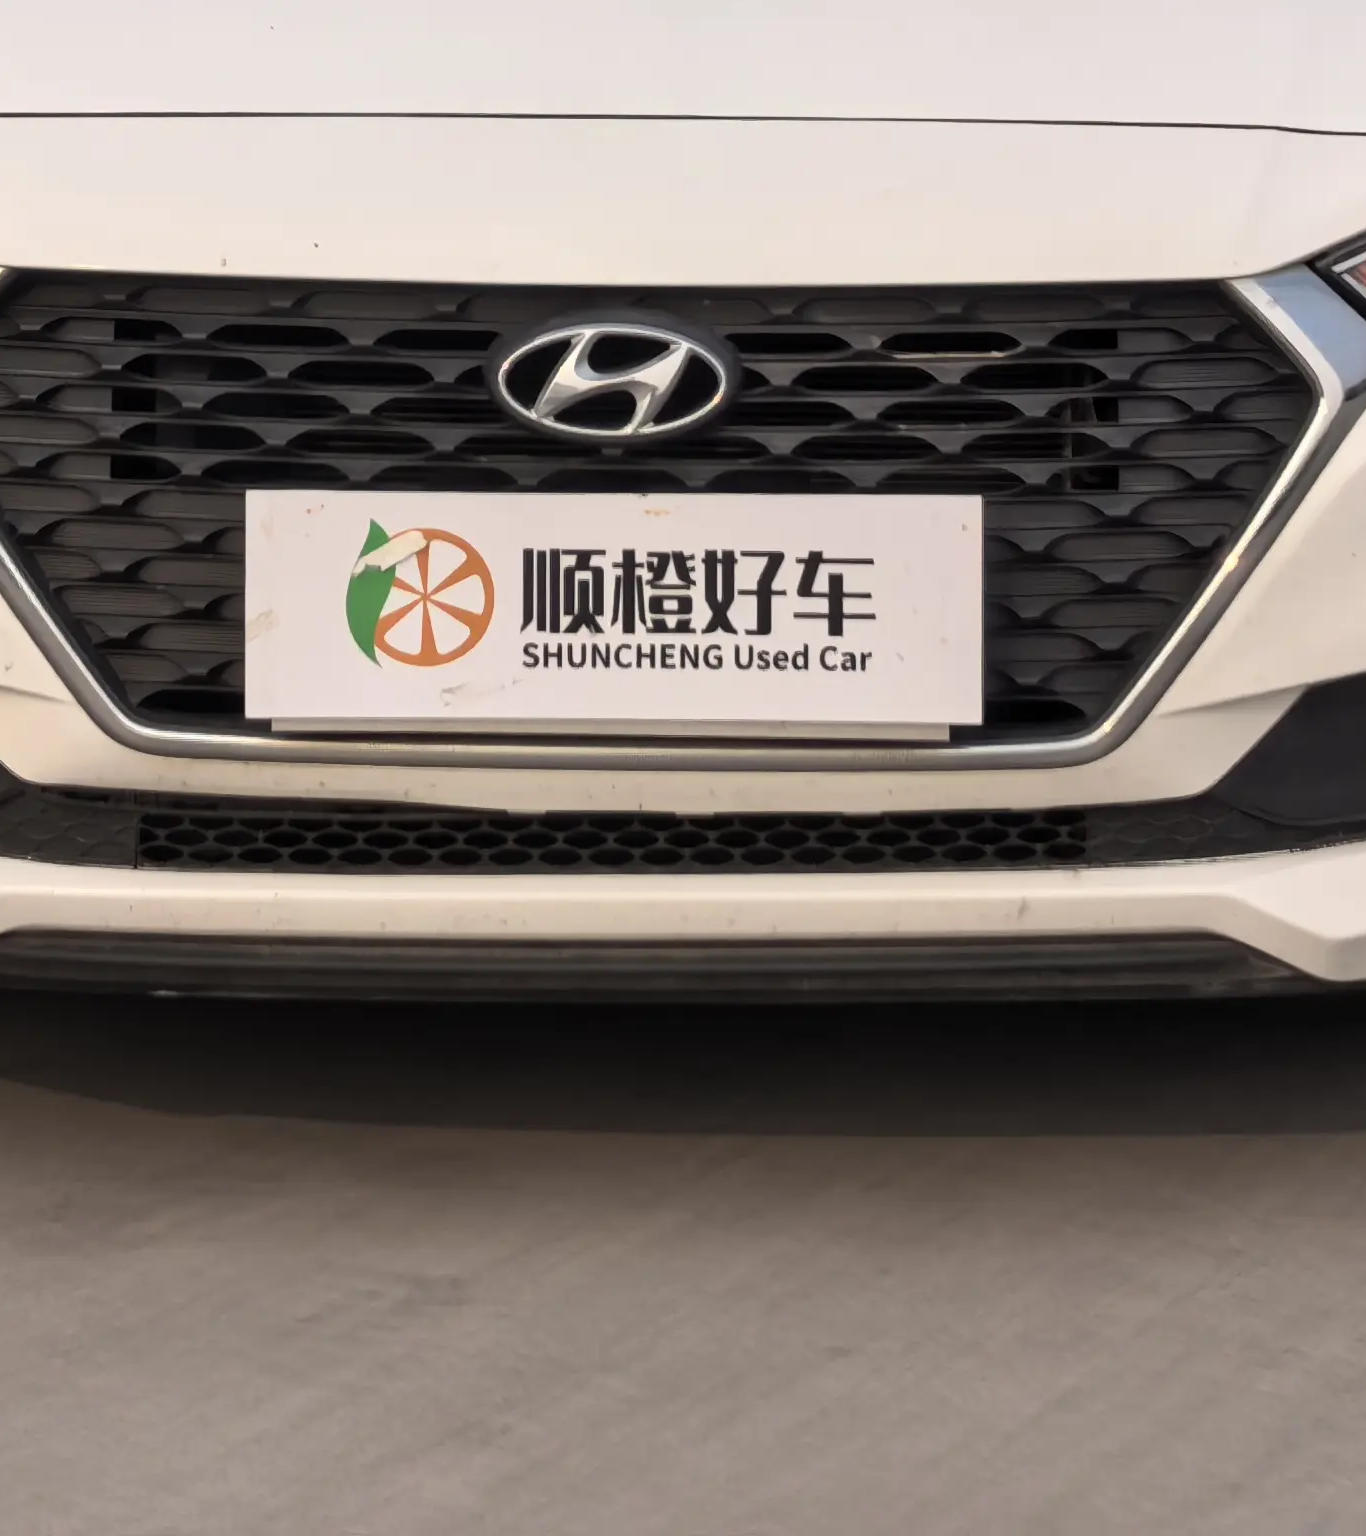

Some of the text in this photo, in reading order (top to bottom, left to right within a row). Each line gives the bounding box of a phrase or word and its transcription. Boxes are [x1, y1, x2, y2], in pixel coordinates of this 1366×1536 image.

[520, 547, 877, 637] 顺橙好车
[522, 642, 873, 673] SHUNCHENG Used Car
